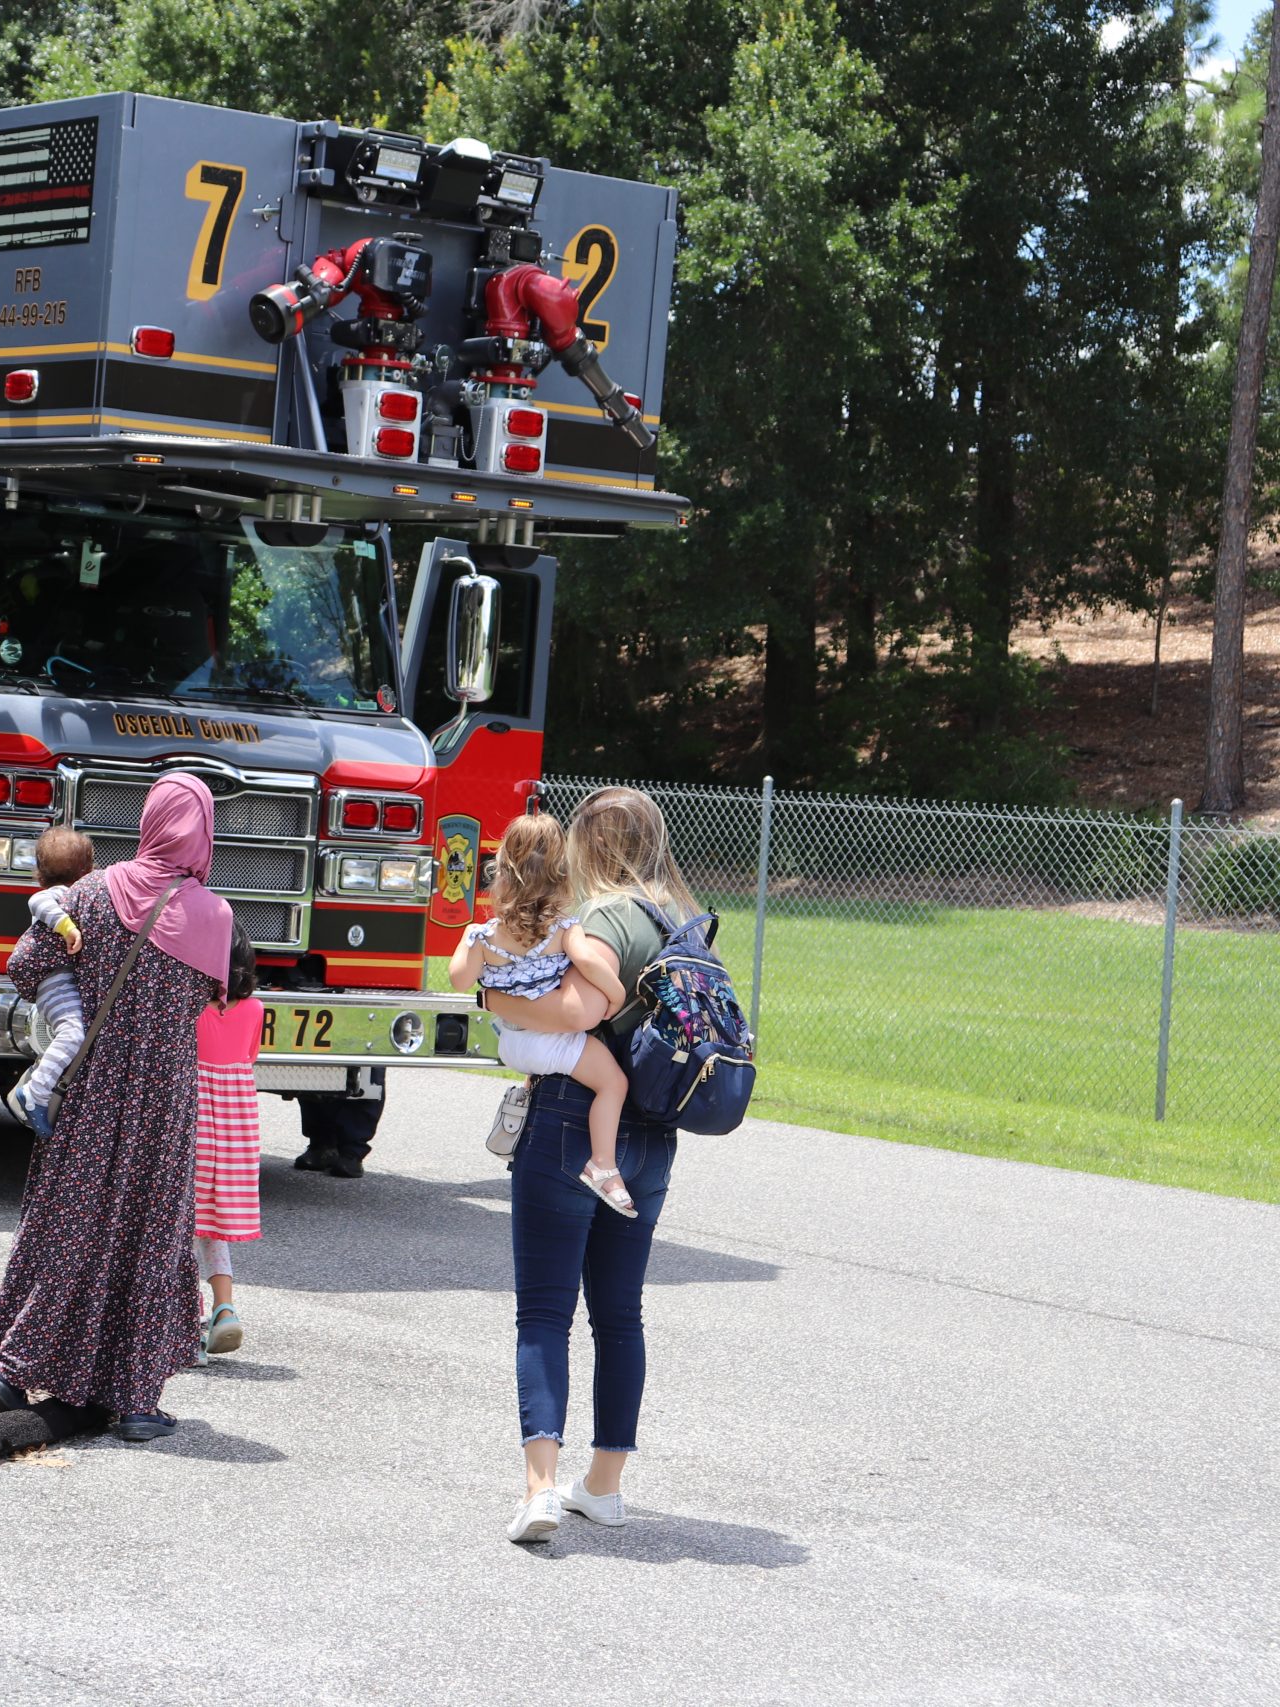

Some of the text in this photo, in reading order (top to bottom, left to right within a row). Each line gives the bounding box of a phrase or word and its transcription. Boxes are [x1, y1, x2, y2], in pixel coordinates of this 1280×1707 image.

[185, 160, 619, 353] 7 2
[15, 266, 41, 293] RFB
[113, 712, 261, 744] OSCEOLA COUNTY
[291, 1008, 335, 1051] 72
